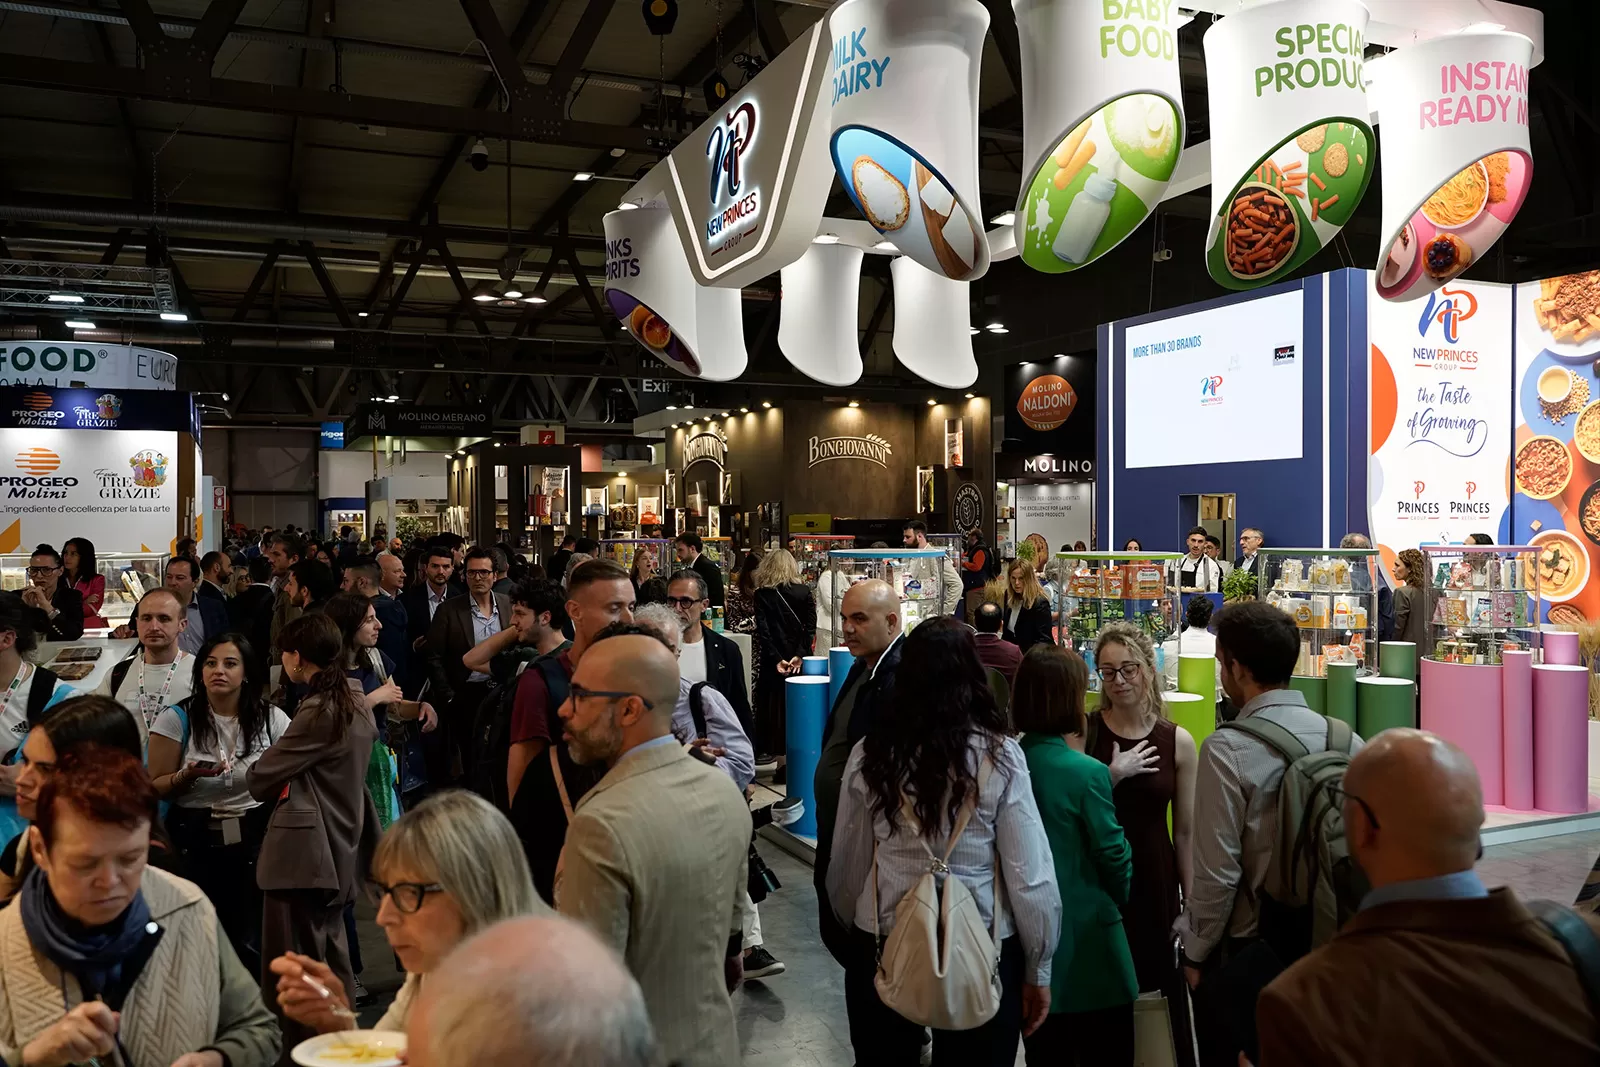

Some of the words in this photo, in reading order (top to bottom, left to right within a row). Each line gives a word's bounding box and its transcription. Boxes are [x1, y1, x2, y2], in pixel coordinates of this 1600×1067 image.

[1100, 24, 1174, 61] FOOD
[1419, 94, 1512, 130] READY
[724, 233, 742, 251] GROUP
[1133, 347, 1149, 358] MORE
[1150, 343, 1166, 355] THAN
[1167, 340, 1175, 353] 30
[1177, 335, 1202, 351] BRANDS
[1434, 363, 1457, 371] GROUP
[643, 379, 672, 393] Exit
[1032, 382, 1062, 393] MOLINO
[1417, 387, 1436, 403] the
[1439, 382, 1472, 405] Taste
[12, 410, 65, 418] PROGEO
[77, 411, 100, 419] TRE
[398, 412, 439, 421] MOLINO
[442, 412, 486, 422] MERANO
[18, 417, 58, 426] Molini
[76, 419, 118, 427] GRAZIE
[1407, 412, 1418, 438] of
[1419, 407, 1478, 444] Growing
[809, 436, 886, 463] BONGIOVANNI
[1024, 459, 1092, 472] MOLINO
[0, 477, 79, 487] PROGEO
[99, 477, 133, 488] TRE
[7, 487, 68, 499] Molini
[99, 488, 161, 499] GRAZIE
[957, 487, 979, 502] MASTRO
[58, 505, 113, 513] d'eccellenza
[129, 505, 137, 513] la
[1397, 501, 1440, 514] PRINCES
[1450, 501, 1490, 514] PRINCES
